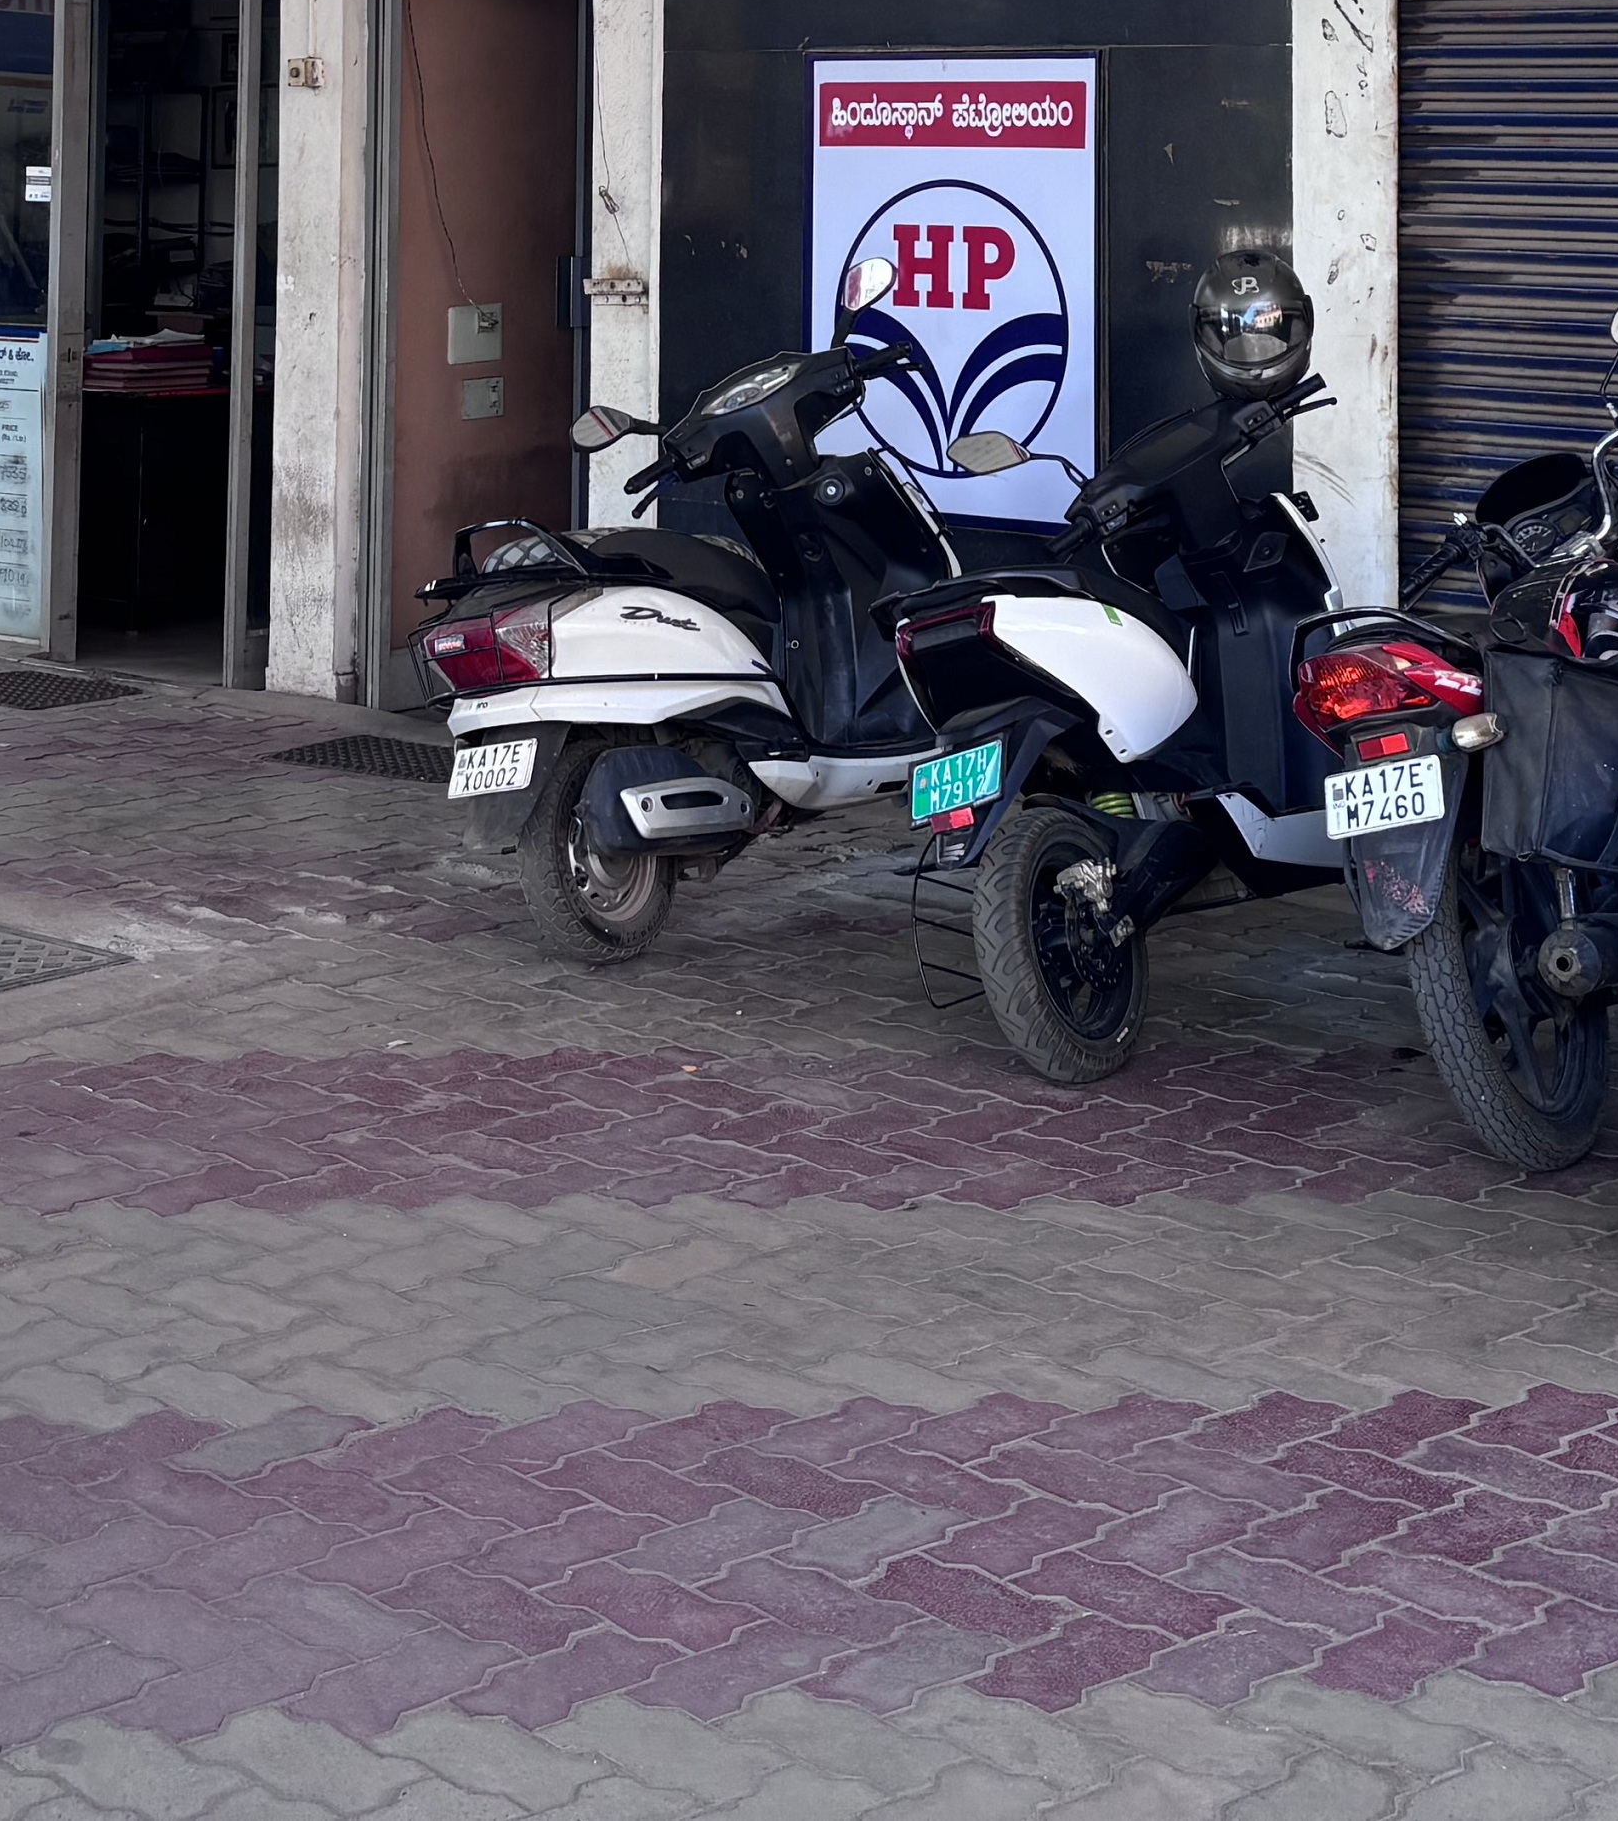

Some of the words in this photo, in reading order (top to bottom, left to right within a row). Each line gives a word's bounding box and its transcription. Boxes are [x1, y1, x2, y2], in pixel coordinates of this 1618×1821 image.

[951, 93, 1073, 138] ಪೆಟ್ರೋಲಿಯಂ
[892, 223, 1016, 311] HP
[2, 424, 18, 433] PRICE
[467, 743, 523, 770] KA17E
[931, 748, 988, 787] KA17H
[462, 766, 518, 793] X0002
[930, 774, 988, 812] M7912
[1345, 762, 1423, 801] KA17E
[1346, 792, 1425, 829] M7460
